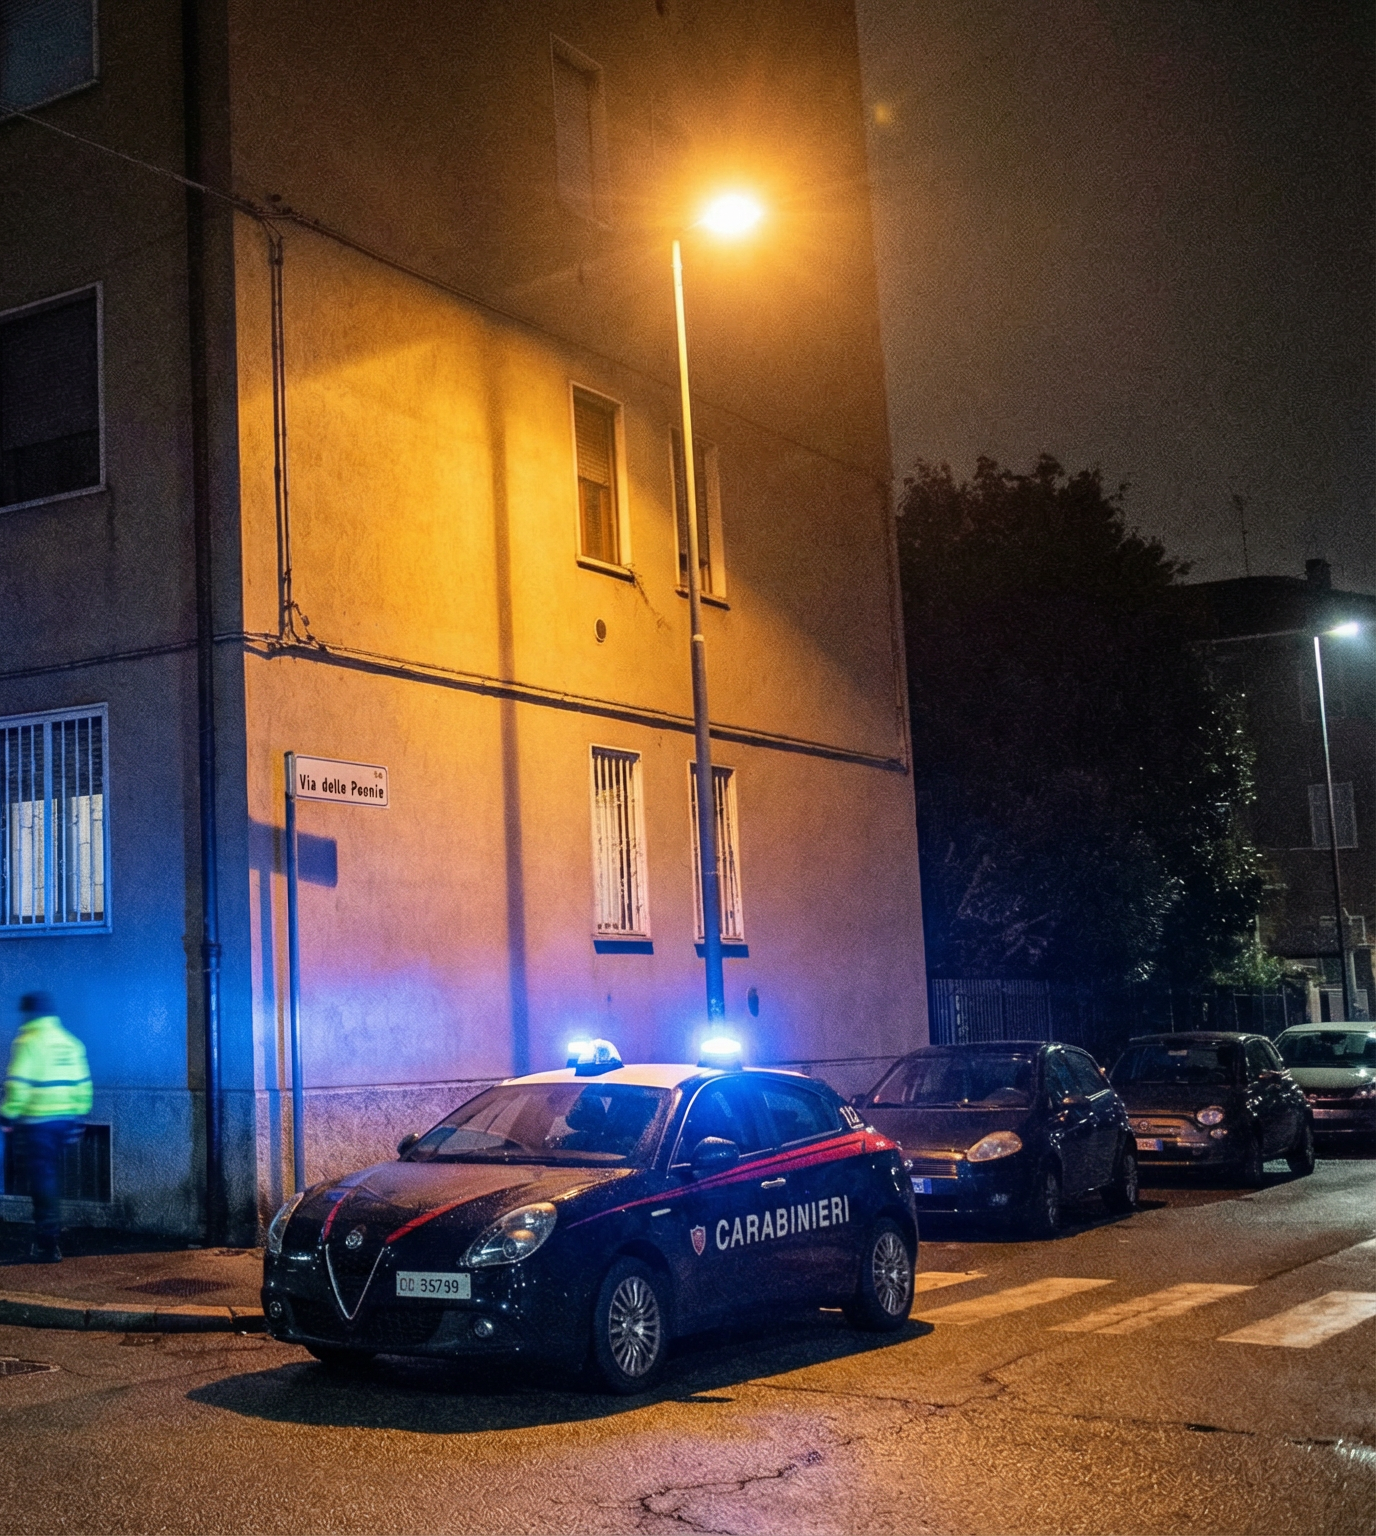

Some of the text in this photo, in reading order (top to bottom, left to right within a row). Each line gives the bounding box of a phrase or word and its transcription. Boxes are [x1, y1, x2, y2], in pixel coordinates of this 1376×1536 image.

[299, 773, 316, 791] Via
[322, 777, 346, 795] delle
[716, 1195, 849, 1250] CARABINIERI
